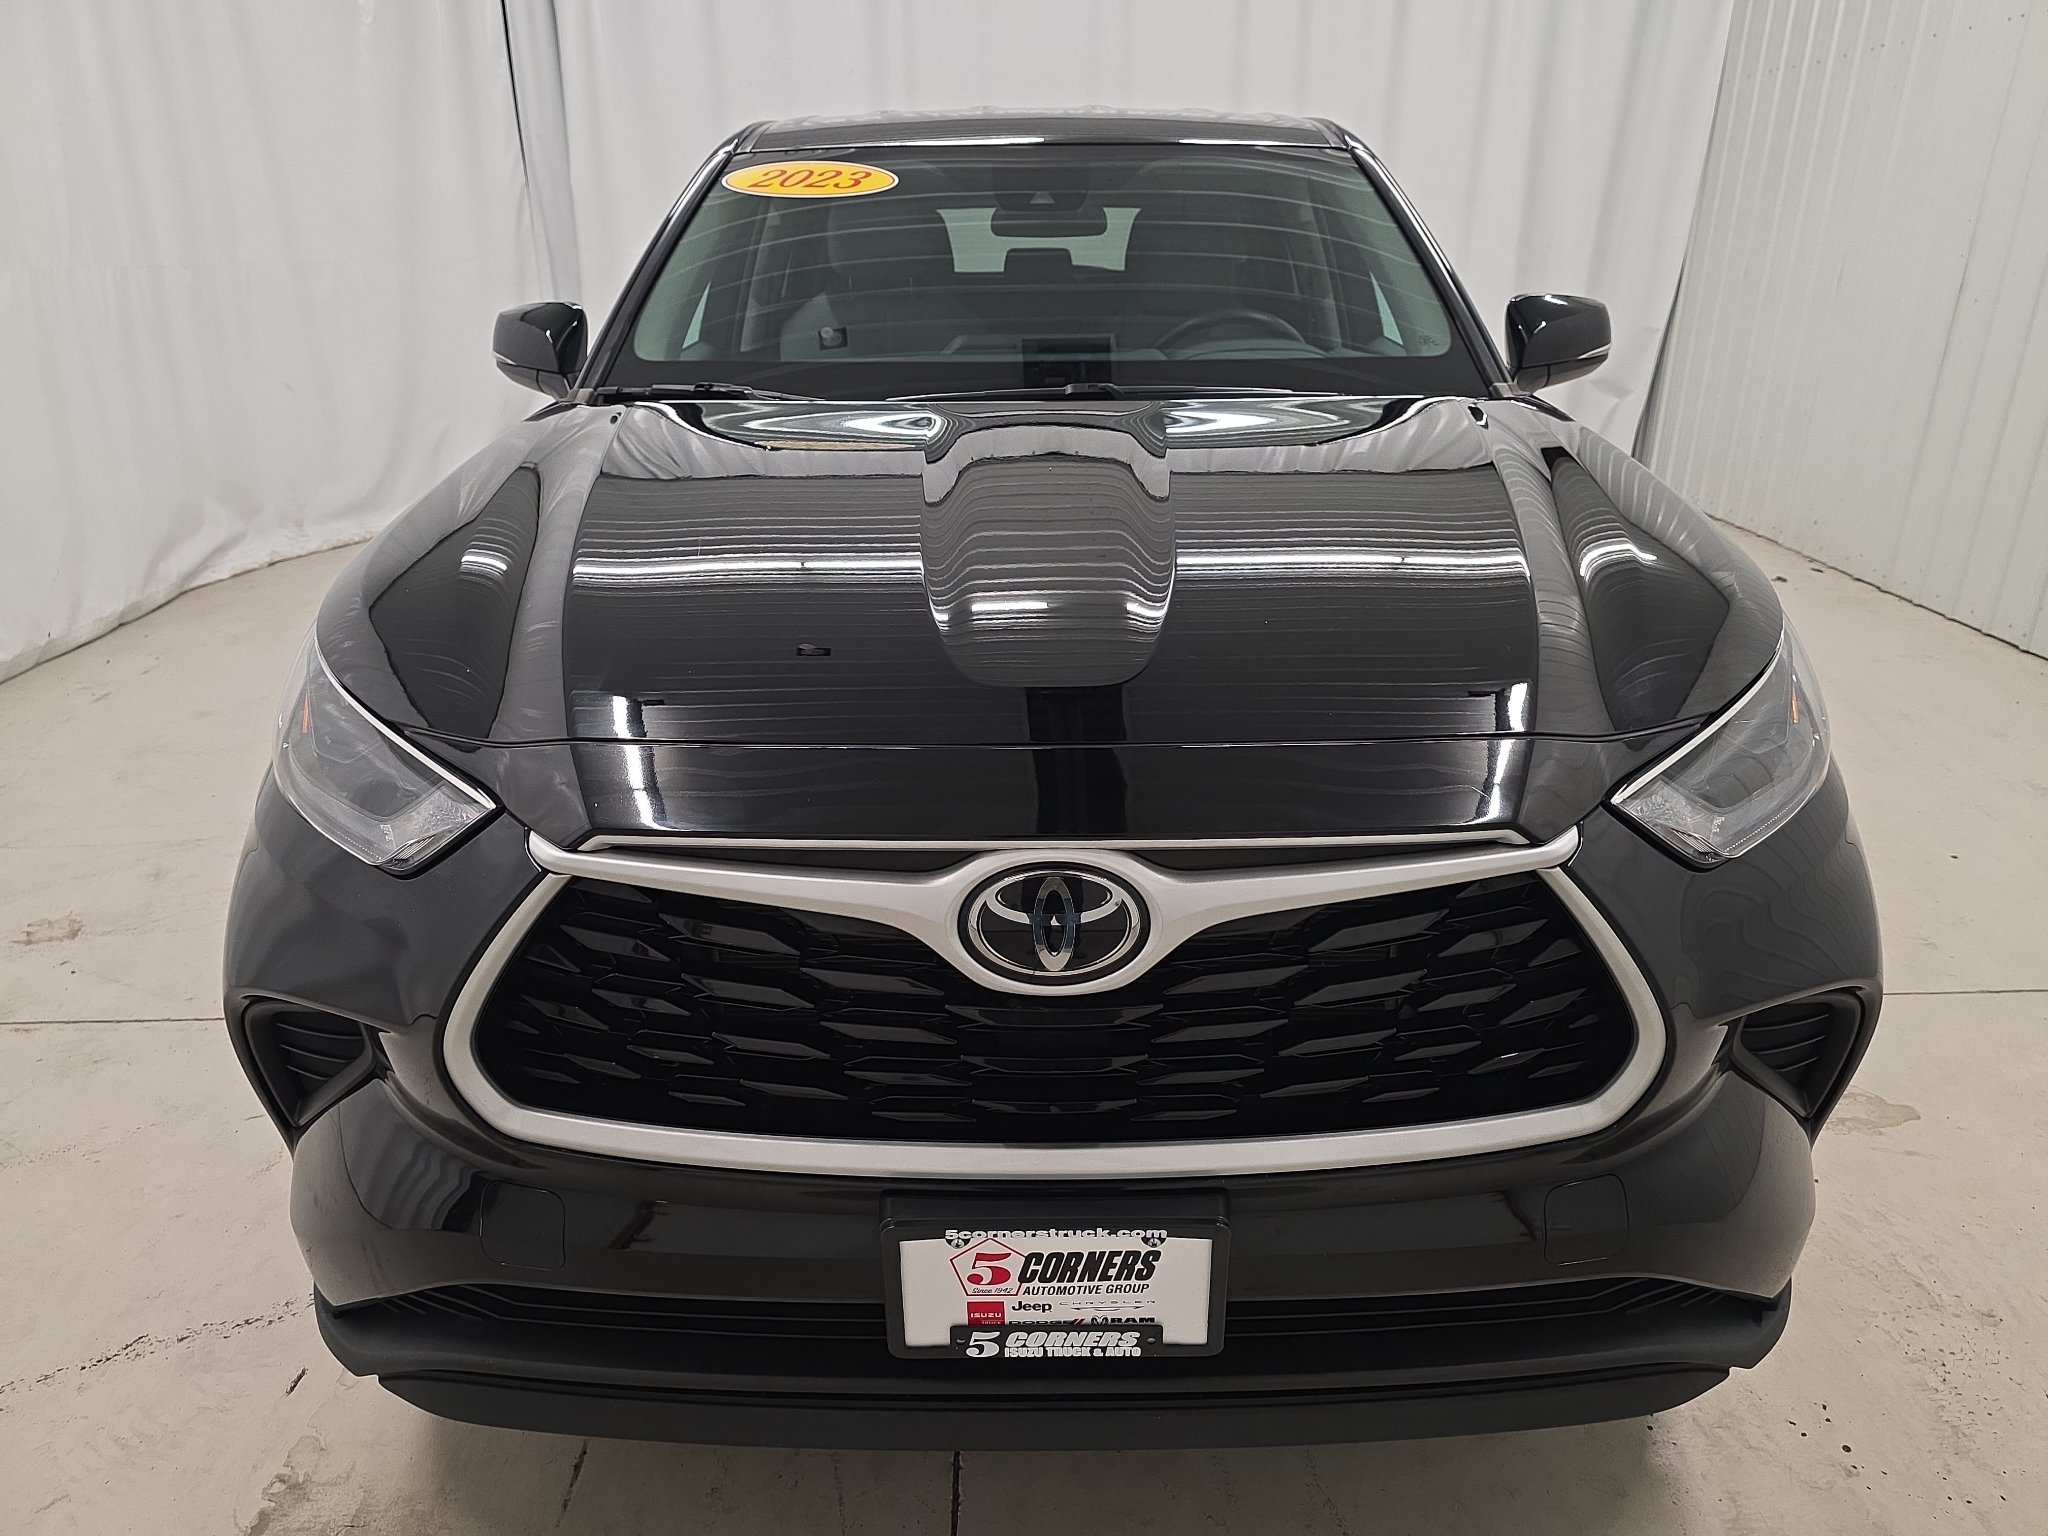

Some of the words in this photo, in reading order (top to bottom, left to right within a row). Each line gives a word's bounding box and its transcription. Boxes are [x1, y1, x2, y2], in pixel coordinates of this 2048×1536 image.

[749, 168, 872, 189] 2023
[944, 1228, 1168, 1240] 5cornerstruck.com
[966, 1252, 1012, 1286] 5
[1017, 1249, 1162, 1284] CORNERS
[994, 1286, 1014, 1294] 1942
[1022, 1284, 1102, 1296] AUTOMOTIVE
[1105, 1283, 1150, 1295] GROUP
[1011, 1300, 1053, 1313] Jeep
[1110, 1316, 1156, 1324] RAM
[965, 1331, 1001, 1358] 5
[1005, 1331, 1141, 1348] CORNERS
[1004, 1346, 1044, 1358] ISUZU
[1045, 1346, 1092, 1357] TRUCK
[1092, 1347, 1104, 1357] &
[1105, 1346, 1142, 1357] AUTO
